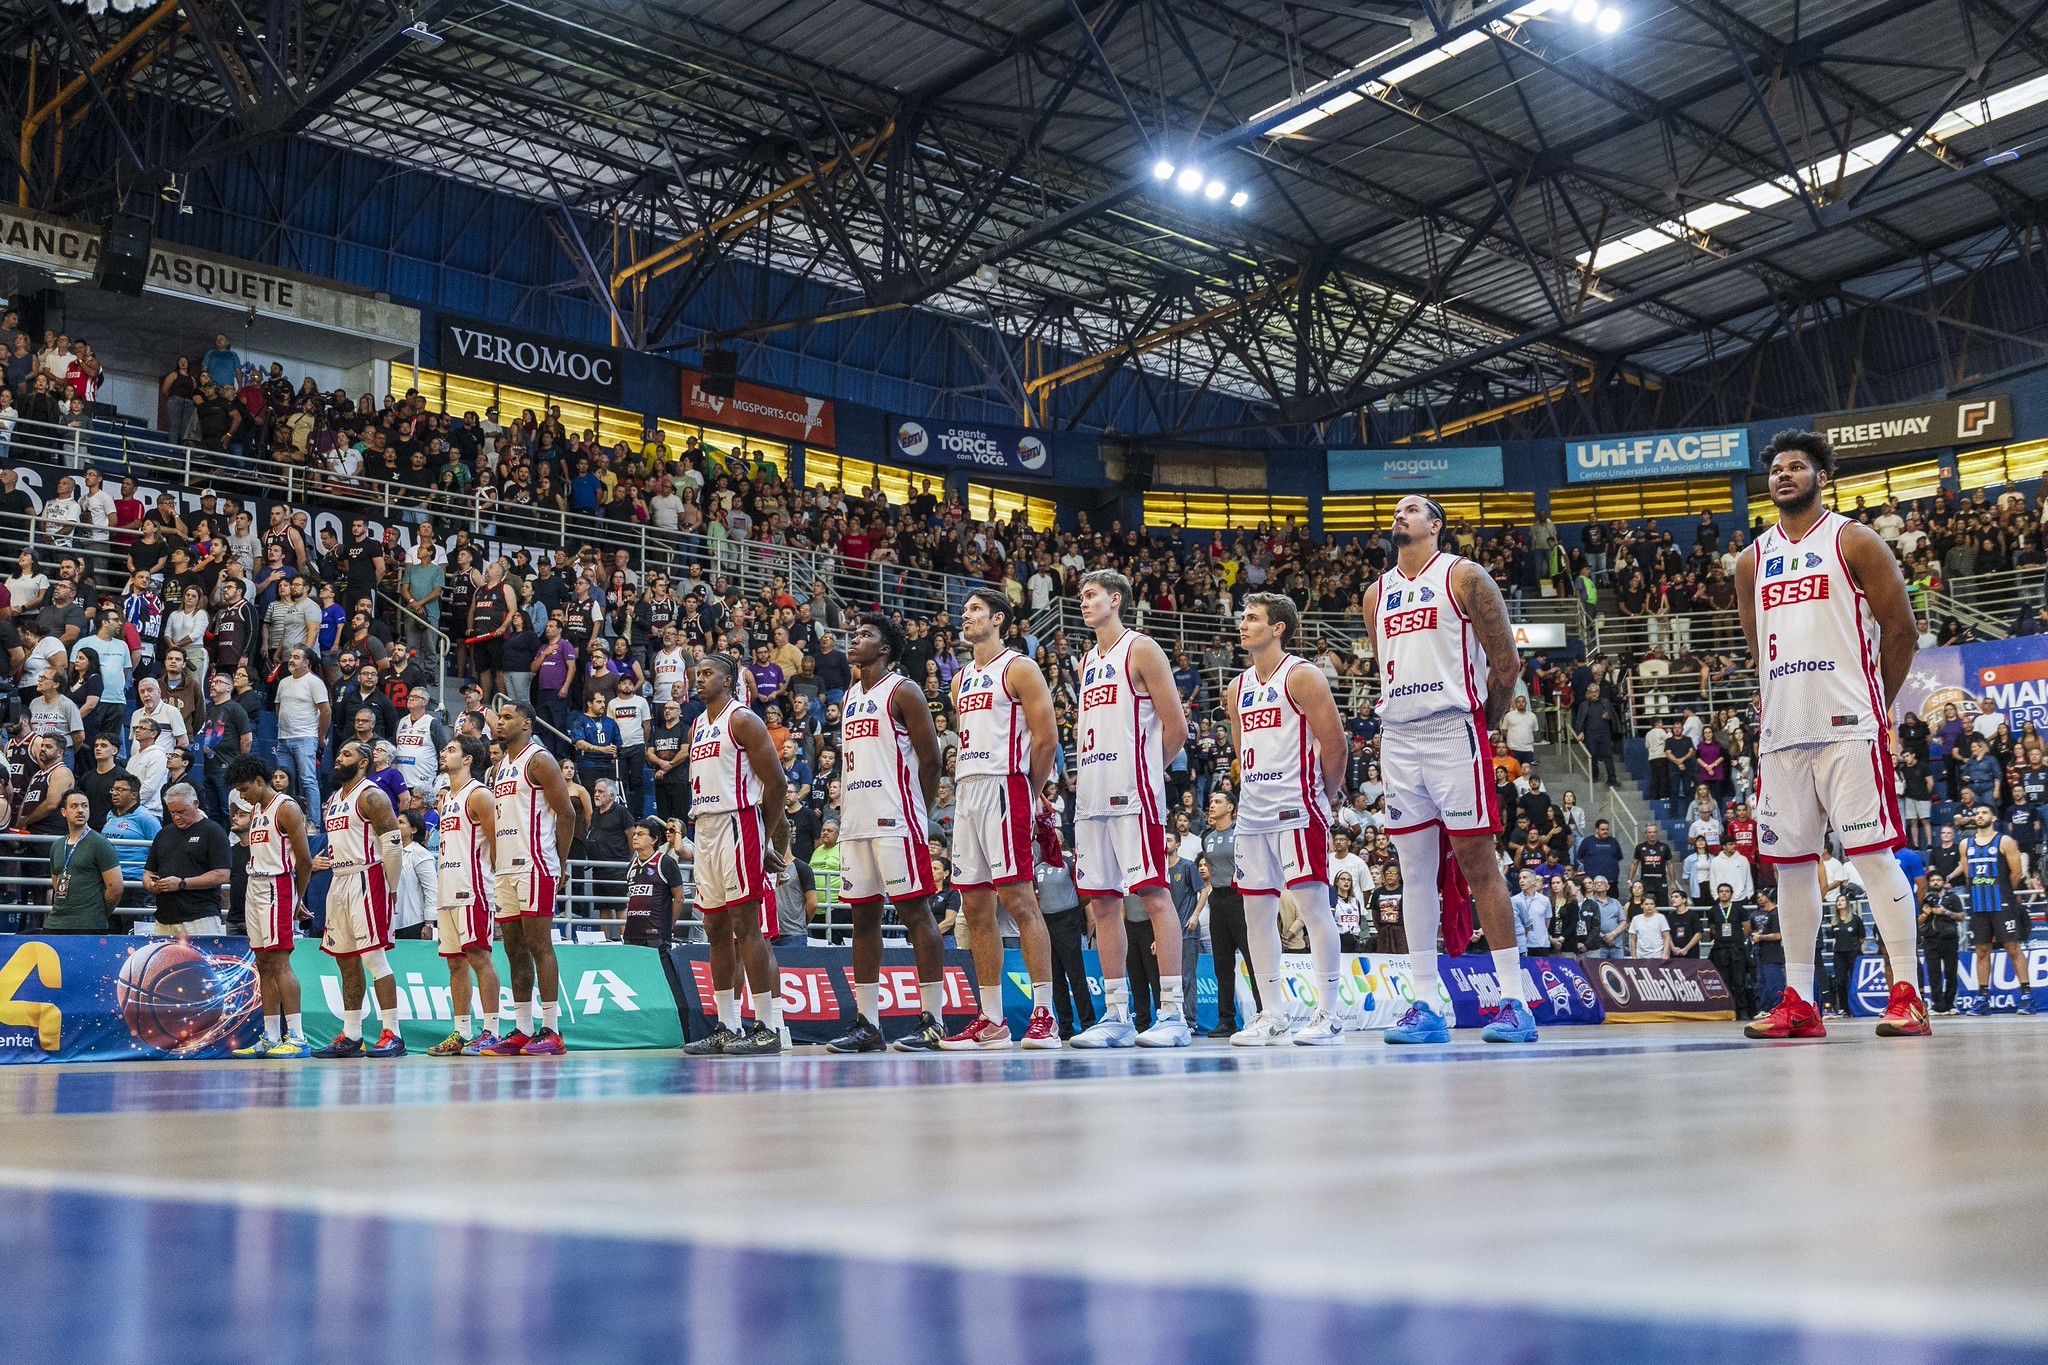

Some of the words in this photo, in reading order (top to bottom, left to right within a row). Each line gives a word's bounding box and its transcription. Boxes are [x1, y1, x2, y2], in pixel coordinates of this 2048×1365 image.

[151, 253, 293, 308] ASQUETE
[451, 326, 613, 386] VEROMOC
[733, 399, 823, 427] MGSPORTS.COM.BR
[958, 430, 987, 440] gente
[1827, 415, 1931, 445] FREEWAY
[902, 430, 924, 448] EPTV
[957, 453, 972, 461] com
[1021, 444, 1042, 462] EPTV
[1577, 433, 1740, 468] Uni-FACEF
[1580, 471, 1606, 479] Centro
[1609, 465, 1659, 477] Universitário
[1661, 464, 1700, 474] Municipal
[1768, 577, 1822, 607] SESI
[1389, 609, 1431, 635] SESI
[1769, 633, 1778, 662] 6
[1387, 660, 1395, 685] 9
[1984, 671, 1996, 682] O
[1085, 687, 1113, 709] SESI
[1986, 679, 2048, 710] MAI
[960, 695, 988, 712] SESI
[1245, 709, 1276, 731] SESI
[597, 732, 605, 744] 10
[846, 721, 874, 740] SESI
[398, 736, 422, 745] SESI
[692, 744, 717, 762] SESI
[844, 751, 855, 773] 19
[495, 782, 515, 798] SESI
[1445, 809, 1473, 818] Unimed
[327, 817, 347, 832] SESI
[440, 818, 457, 832] SESI
[1841, 819, 1878, 832] Unimed
[252, 830, 267, 843] SESI
[1976, 865, 1988, 875] 27
[629, 885, 649, 895] SESI
[2005, 920, 2016, 930] 27
[1285, 961, 1314, 970] Prefei
